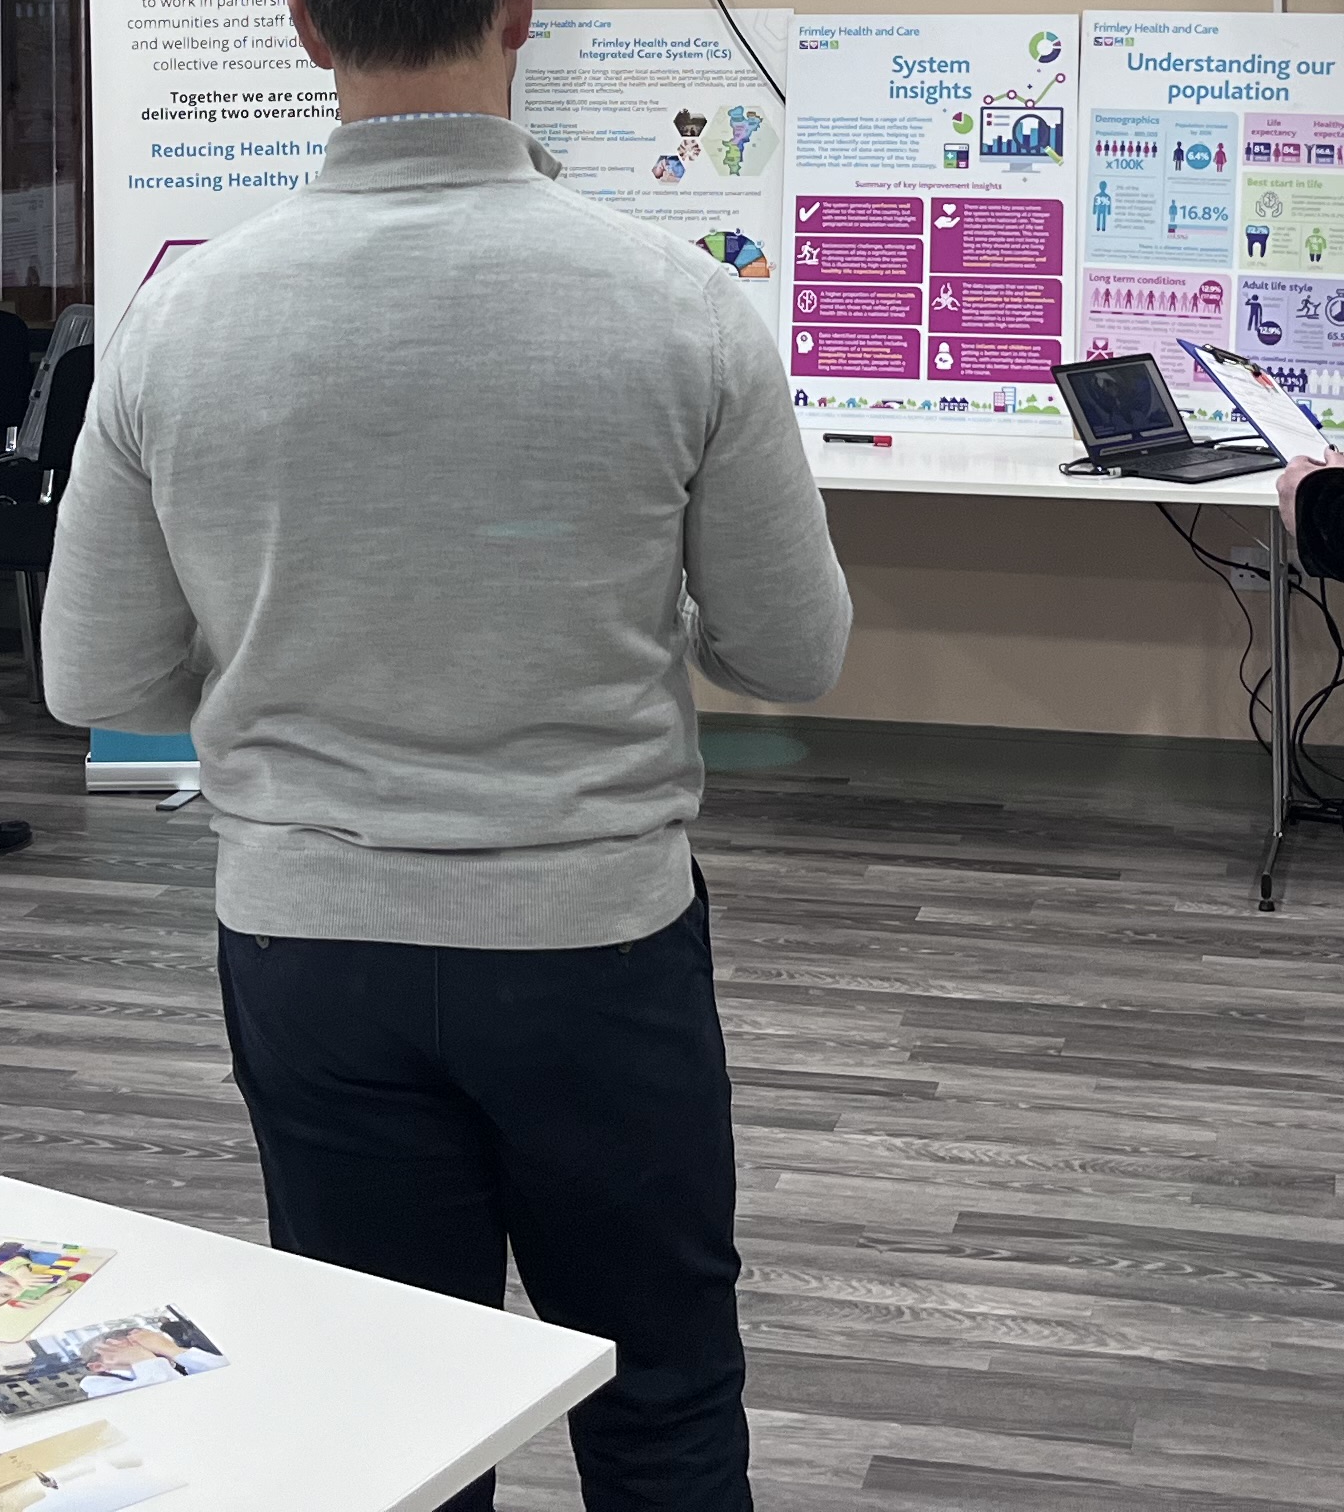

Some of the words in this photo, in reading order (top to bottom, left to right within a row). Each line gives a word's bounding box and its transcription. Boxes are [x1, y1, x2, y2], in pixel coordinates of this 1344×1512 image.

[127, 16, 219, 29] communities
[223, 16, 249, 27] and
[254, 15, 285, 27] staff
[550, 20, 576, 28] Health
[578, 20, 592, 28] and
[594, 20, 611, 28] Care
[1093, 22, 1132, 35] Frimley
[1135, 23, 1169, 34] Health
[1172, 24, 1191, 34] and
[1194, 24, 1219, 34] Care
[799, 27, 836, 39] Frimley
[838, 26, 873, 36] Health
[875, 26, 894, 36] and
[896, 27, 920, 36] Care
[131, 38, 157, 50] and
[162, 37, 230, 52] wellbeing
[234, 37, 247, 48] of
[592, 38, 631, 49] Frimley
[633, 38, 666, 48] Health
[668, 39, 688, 48] and
[690, 38, 719, 48] Care
[579, 50, 634, 61] Integrated
[637, 50, 663, 59] Care
[665, 50, 703, 61] System
[706, 50, 732, 61] (ICS)
[153, 58, 218, 71] collective
[223, 60, 291, 70] resources
[892, 56, 970, 78] System
[1128, 52, 1290, 80] Understanding
[1296, 59, 1335, 75] our
[170, 91, 238, 106] Together
[243, 92, 263, 102] we
[268, 92, 292, 102] are
[889, 80, 972, 104] insights
[1168, 81, 1290, 104] population
[141, 108, 217, 123] delivering
[221, 108, 249, 119] two
[1096, 115, 1159, 126] Demographics
[1314, 121, 1344, 129] Healthy
[1251, 130, 1297, 138] expectancy
[152, 143, 235, 160] Reducing
[241, 141, 300, 157] Health
[1106, 159, 1144, 170] x100K
[128, 173, 223, 192] Increasing
[229, 171, 298, 190] Healthy
[855, 181, 892, 190] Summary
[893, 181, 902, 189] of
[903, 181, 917, 190] key
[919, 182, 969, 191] improvement
[971, 182, 1002, 191] insights
[1247, 178, 1267, 187] Best
[1270, 179, 1293, 188] start
[1296, 180, 1305, 188] in
[1307, 179, 1322, 189] life
[1180, 206, 1228, 221] 16.8%
[1089, 273, 1110, 284] Long
[1113, 275, 1135, 283] term
[1137, 276, 1186, 286] conditions
[1243, 281, 1268, 290] Adult
[1271, 282, 1286, 290] life
[1289, 284, 1313, 294] style
